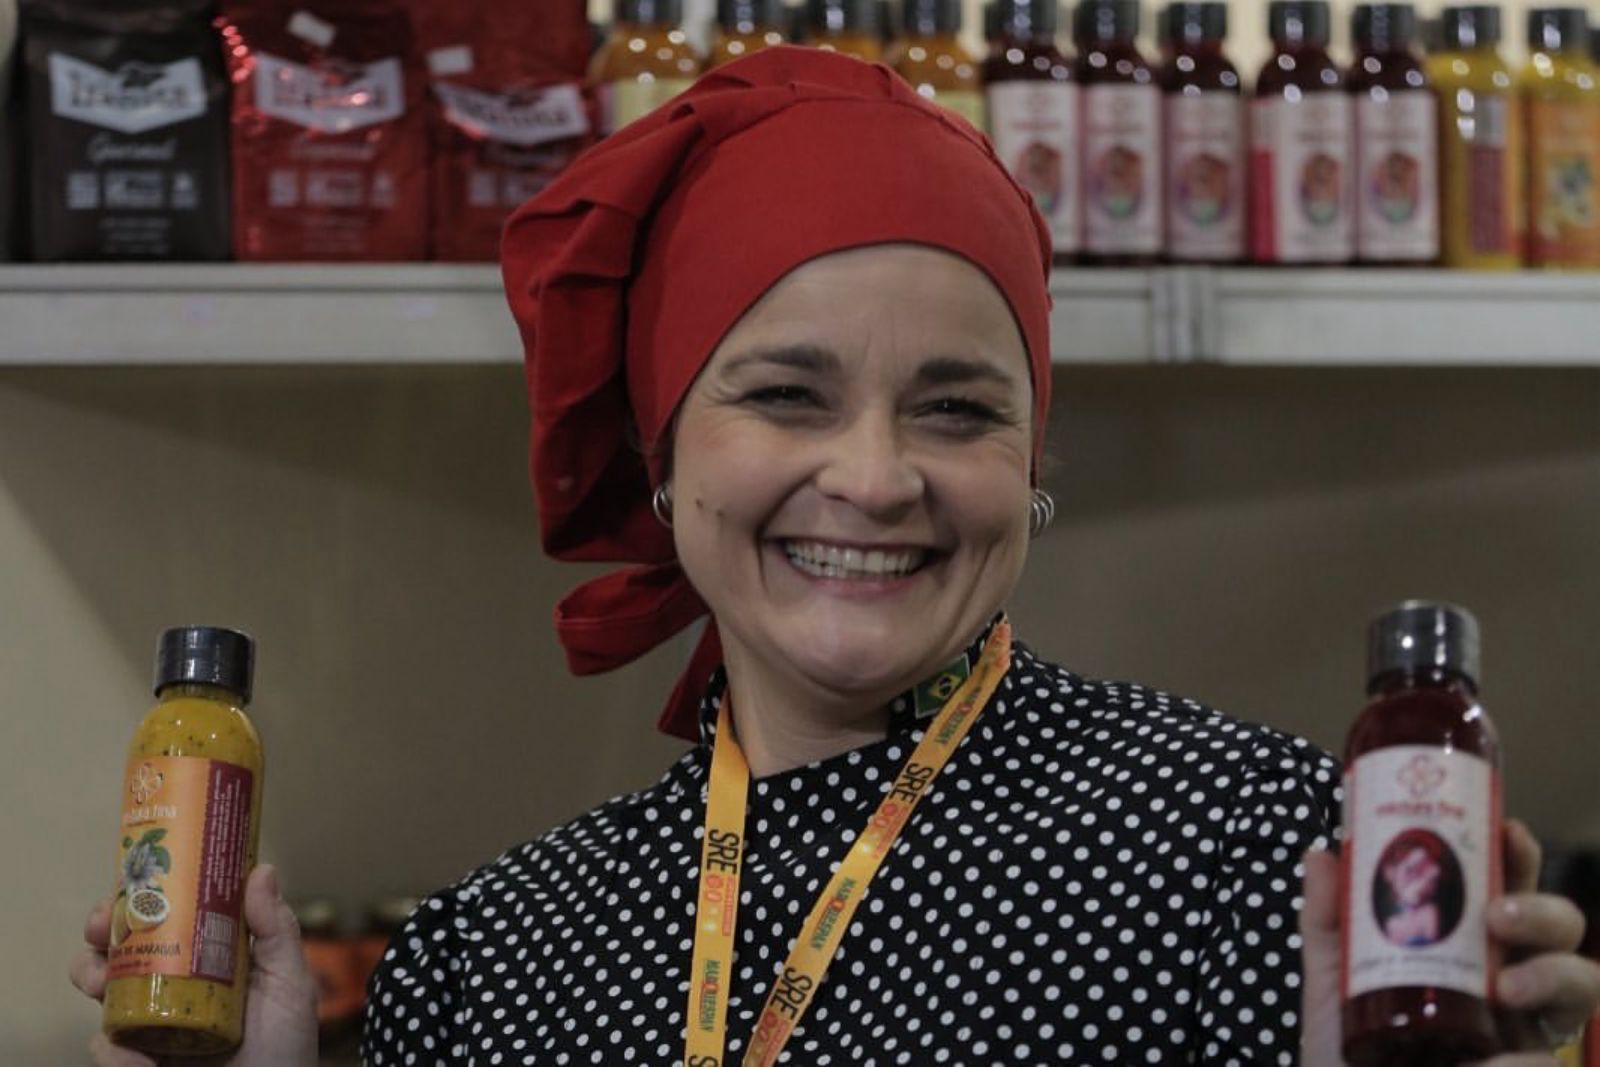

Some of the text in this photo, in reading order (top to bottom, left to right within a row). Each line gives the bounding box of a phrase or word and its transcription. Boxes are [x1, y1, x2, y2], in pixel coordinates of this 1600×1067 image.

[889, 762, 934, 804] SRE
[706, 828, 740, 875] SRE
[769, 967, 813, 1019] SRE
